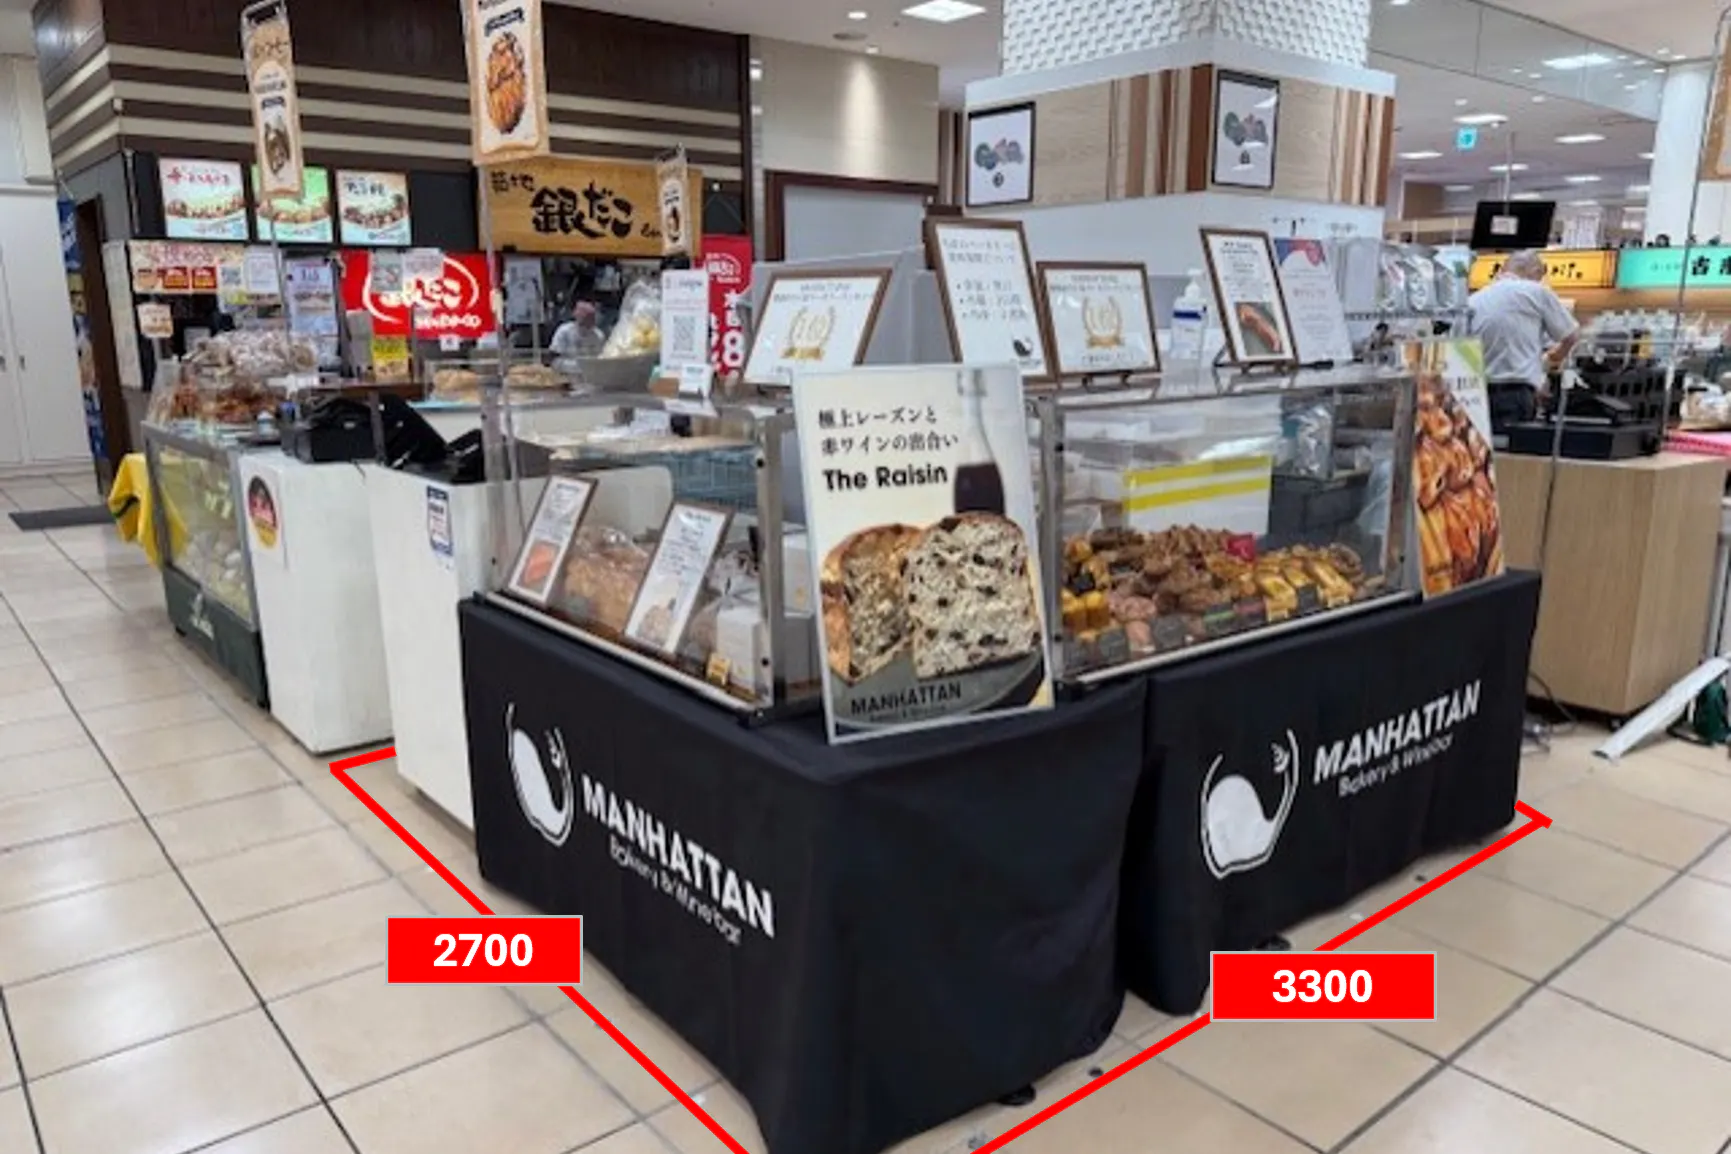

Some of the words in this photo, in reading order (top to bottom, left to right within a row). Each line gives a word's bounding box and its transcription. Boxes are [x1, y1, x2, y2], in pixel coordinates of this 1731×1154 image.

[530, 180, 633, 238] 銀だこ
[818, 406, 937, 429] 極上レーズンと
[821, 431, 959, 456] 赤ワインの出合い
[822, 468, 868, 492] The
[876, 463, 948, 488] Raisin
[851, 681, 962, 716] MANHATTAN
[1313, 679, 1481, 785] MANHATTAN
[582, 773, 775, 939] MANHATTAN
